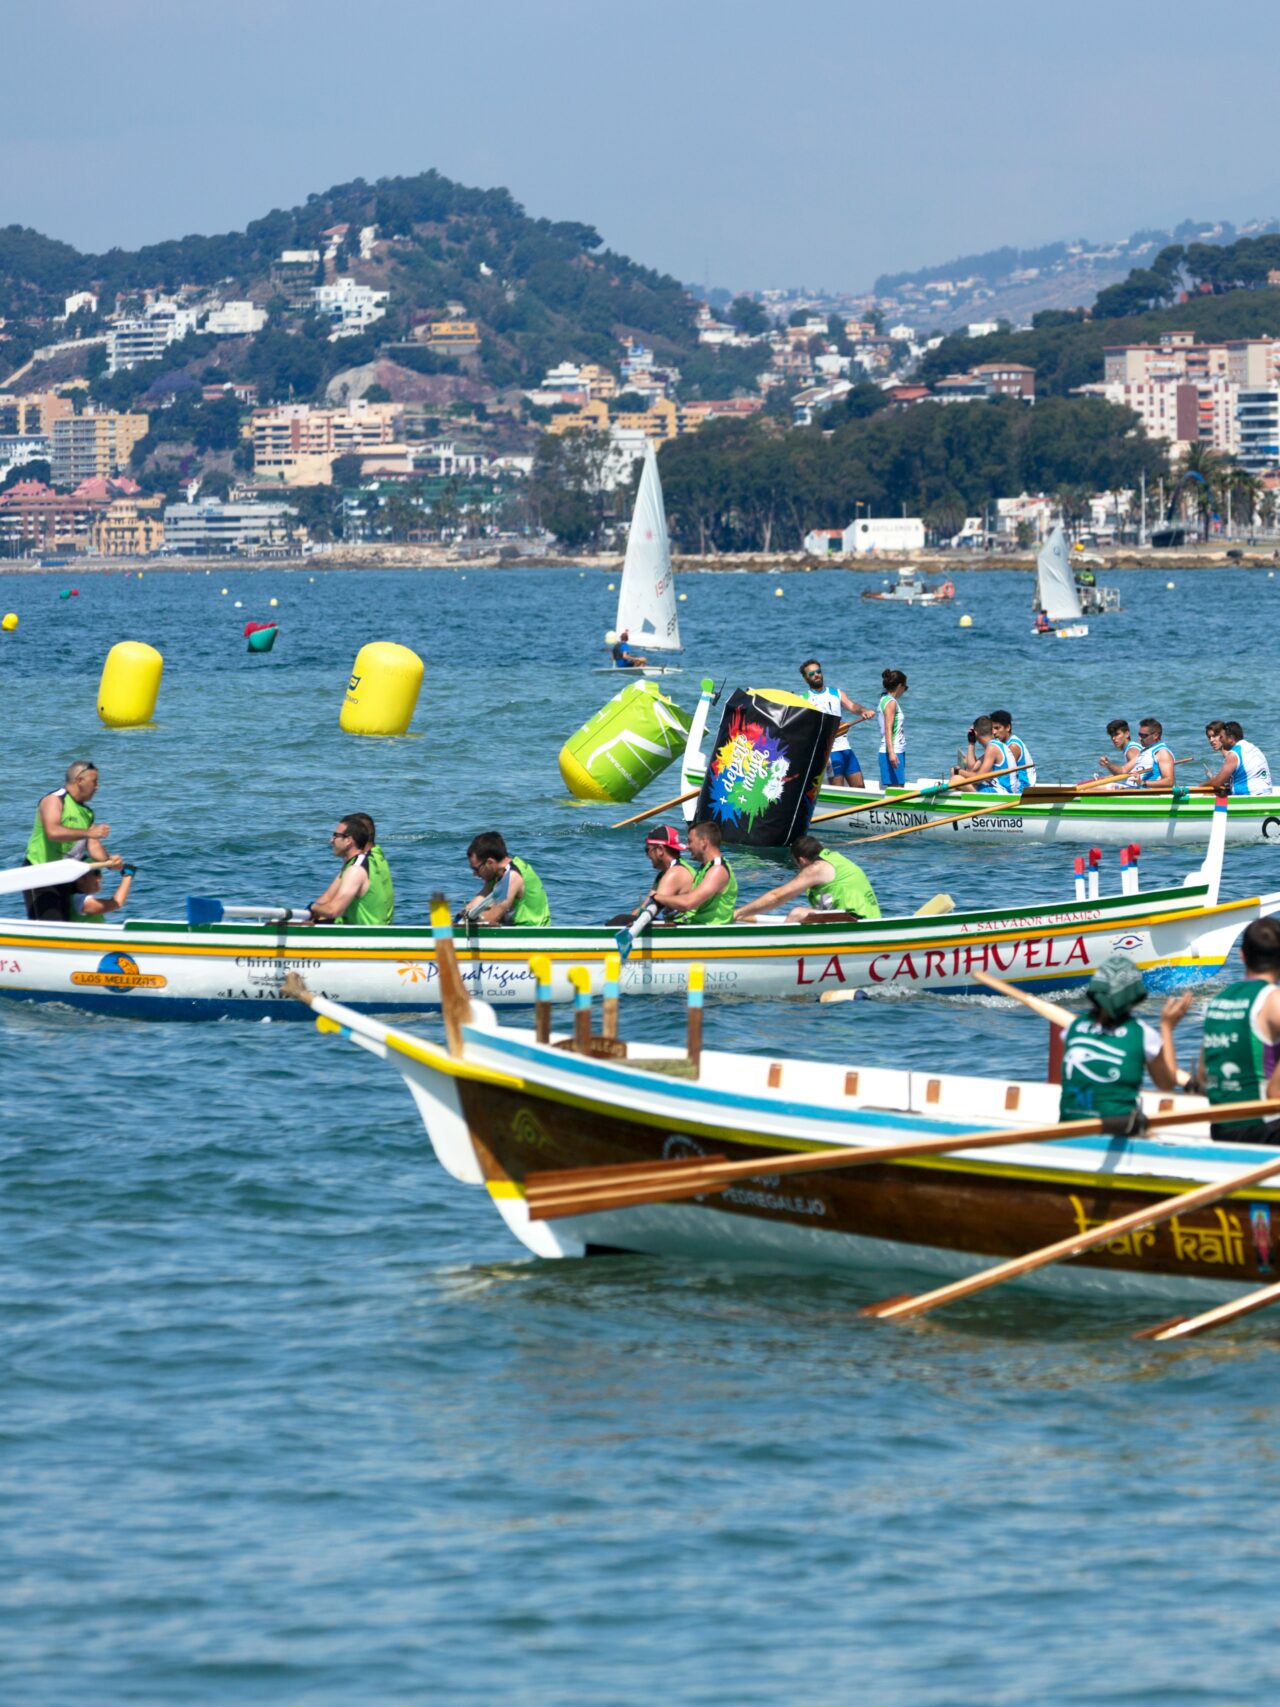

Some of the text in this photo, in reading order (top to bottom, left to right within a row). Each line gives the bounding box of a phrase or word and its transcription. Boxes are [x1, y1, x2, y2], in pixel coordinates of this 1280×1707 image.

[869, 810, 881, 824] EL
[971, 816, 1023, 829] Servimad
[977, 916, 1042, 931] SALVADOR
[235, 956, 321, 970] Chiringuito
[796, 935, 1090, 985] LA CARIHUELA
[81, 974, 101, 983] LOS
[721, 1187, 826, 1215] PEDREGALEJO
[1169, 1207, 1245, 1265] kali
